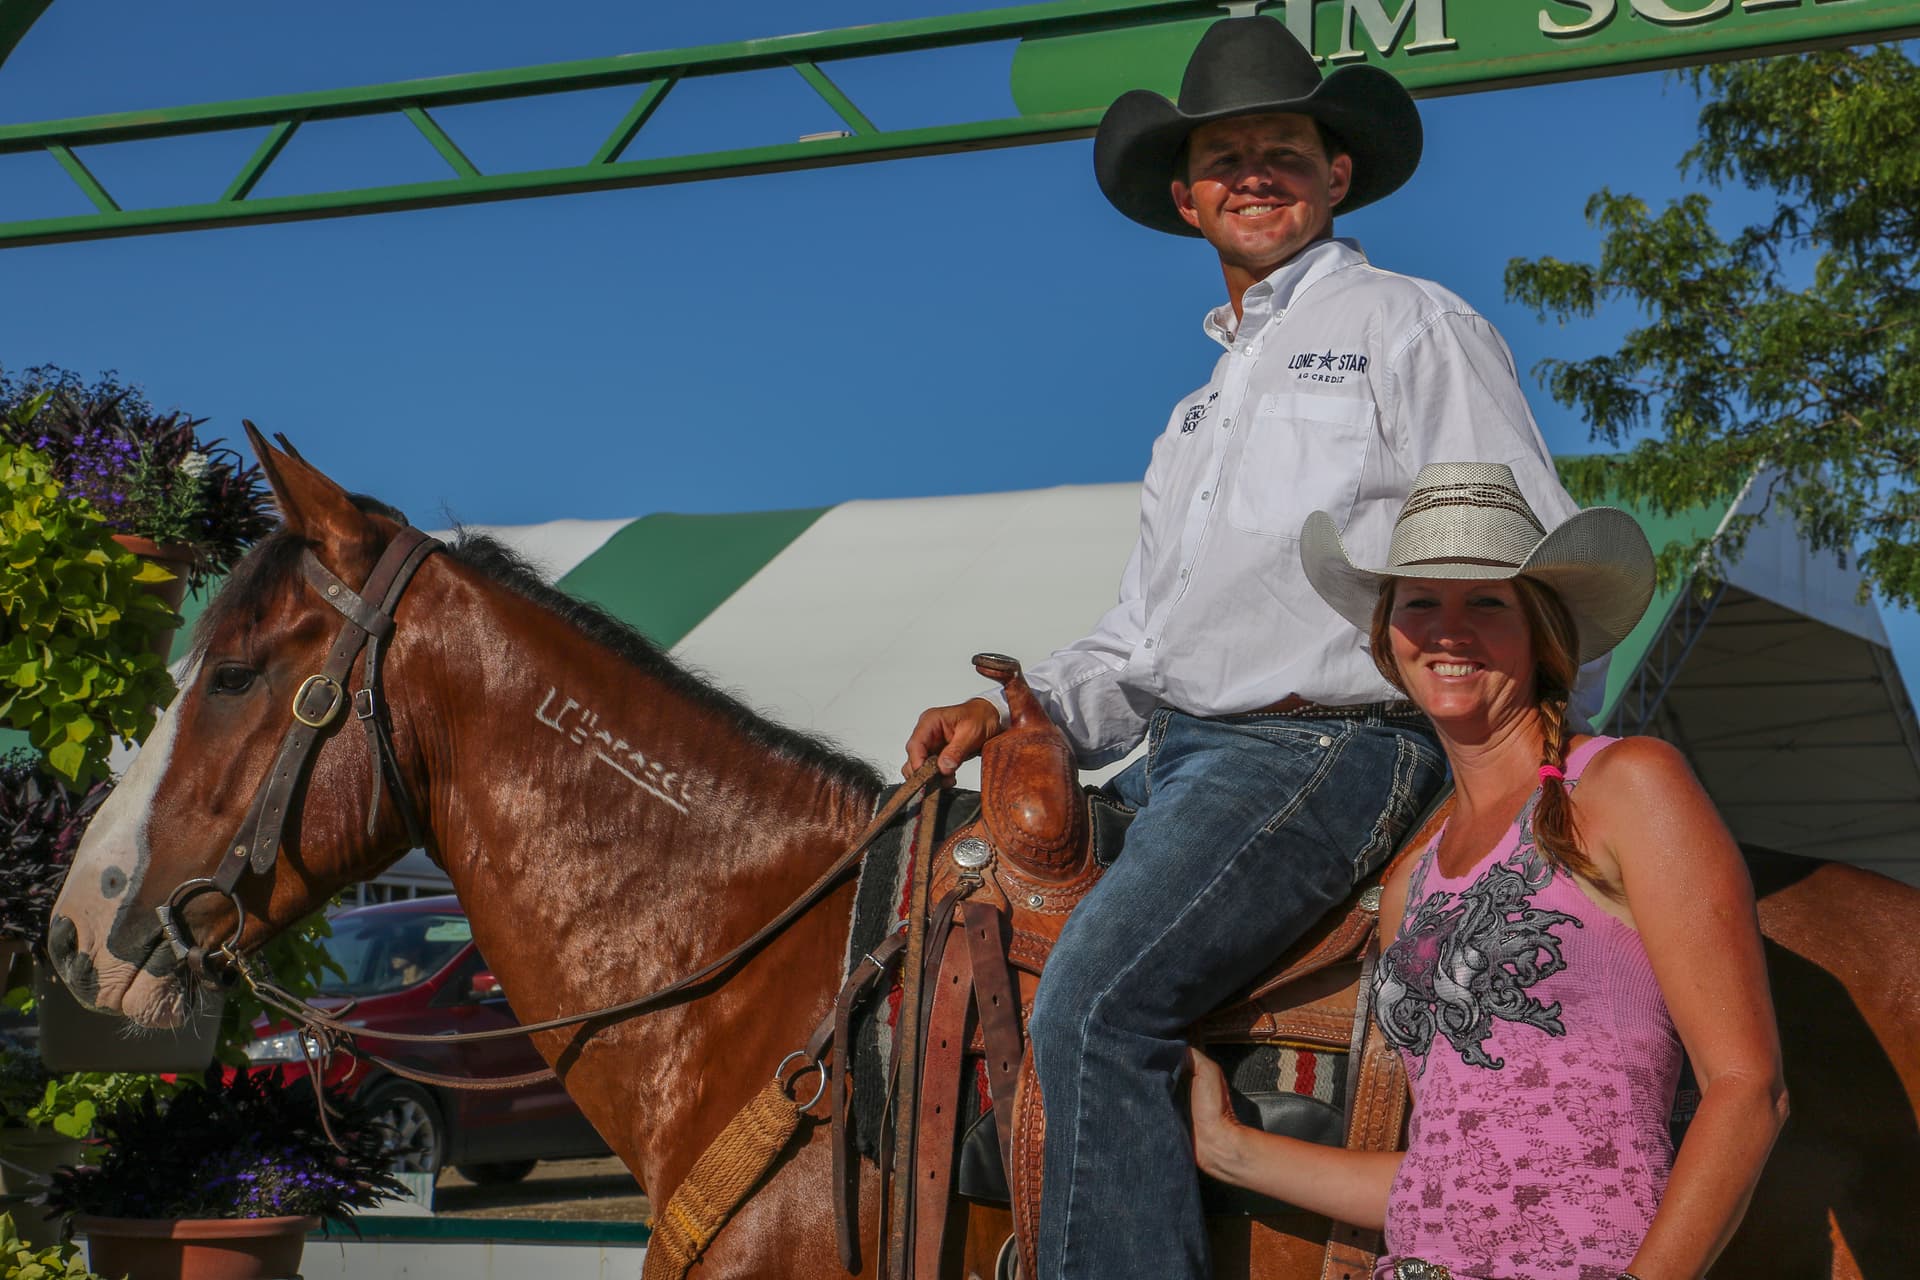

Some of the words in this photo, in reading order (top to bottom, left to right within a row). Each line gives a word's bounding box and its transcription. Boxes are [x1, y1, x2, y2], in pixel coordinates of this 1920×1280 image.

[1288, 353, 1318, 370] LONE
[1338, 353, 1368, 374] STAR
[1311, 373, 1345, 384] CREDIT
